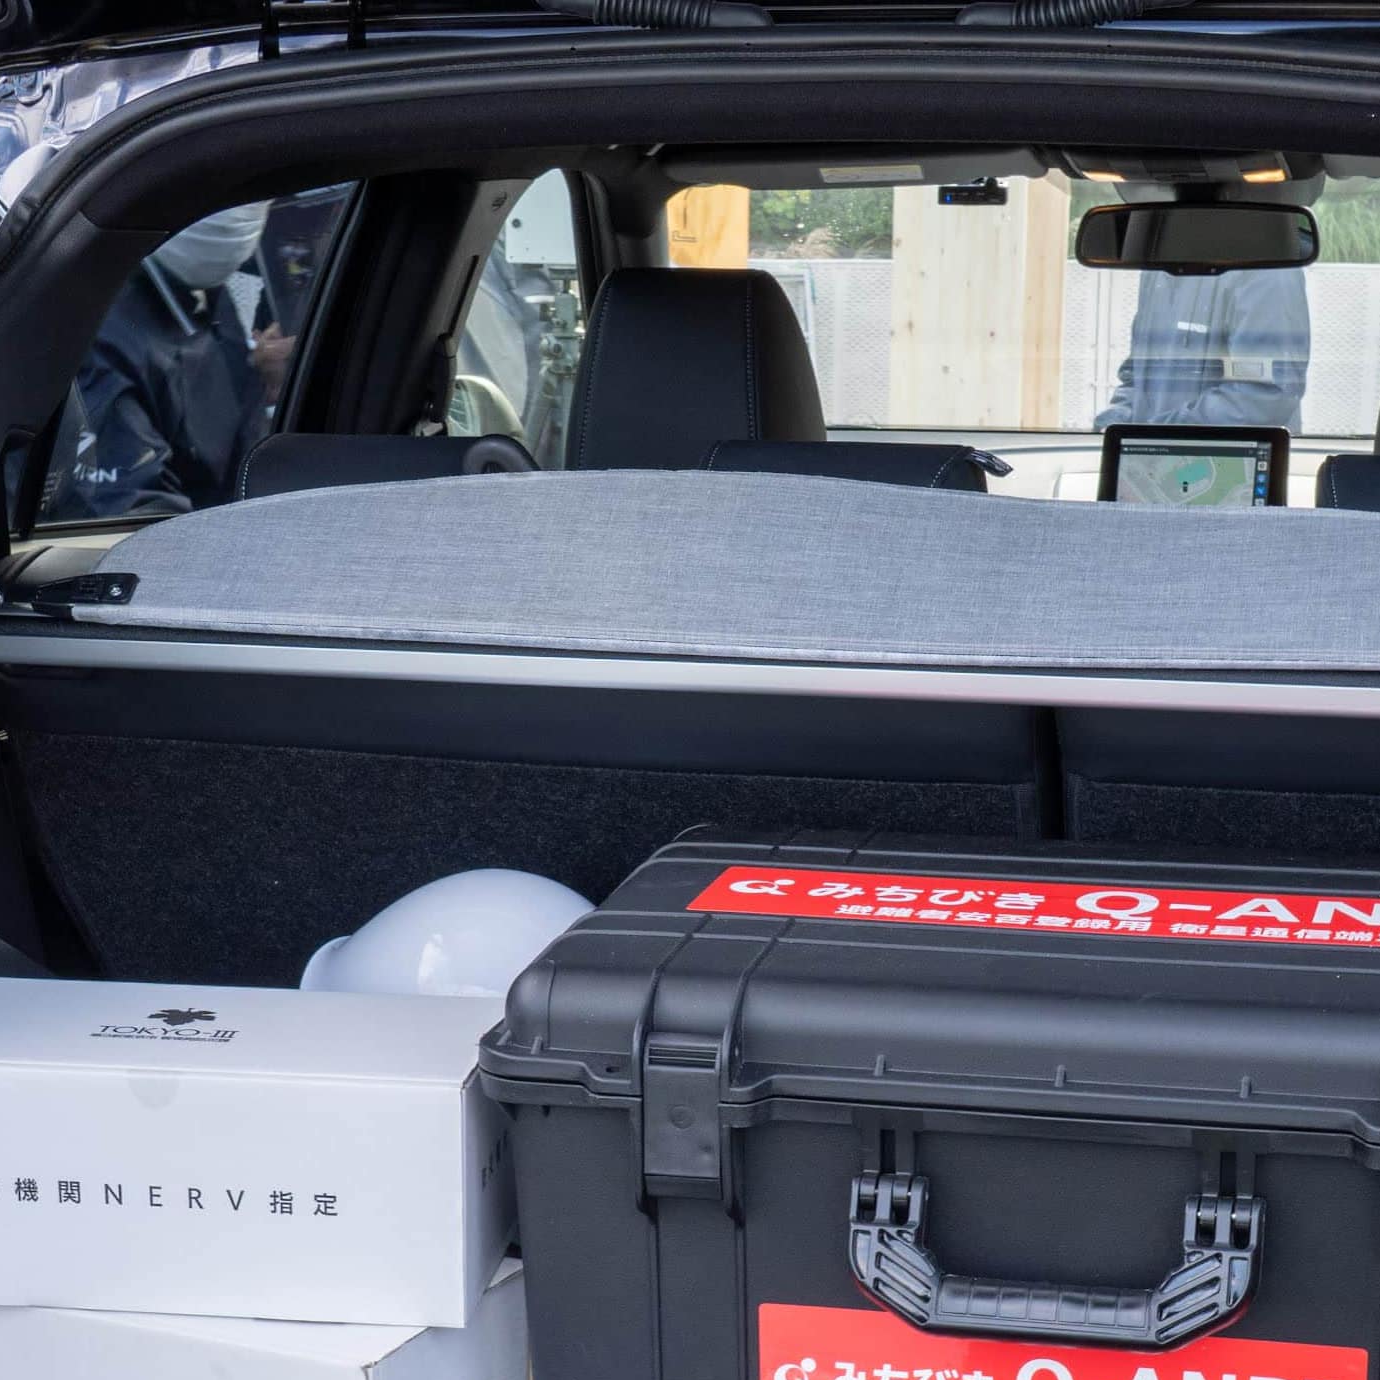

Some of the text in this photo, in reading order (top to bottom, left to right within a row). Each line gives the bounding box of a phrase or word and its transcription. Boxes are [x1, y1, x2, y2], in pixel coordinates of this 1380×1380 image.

[807, 881, 1046, 911] みちびき
[834, 904, 1152, 932] 避難者安否登録用
[99, 1025, 240, 1039] TOKYO-III
